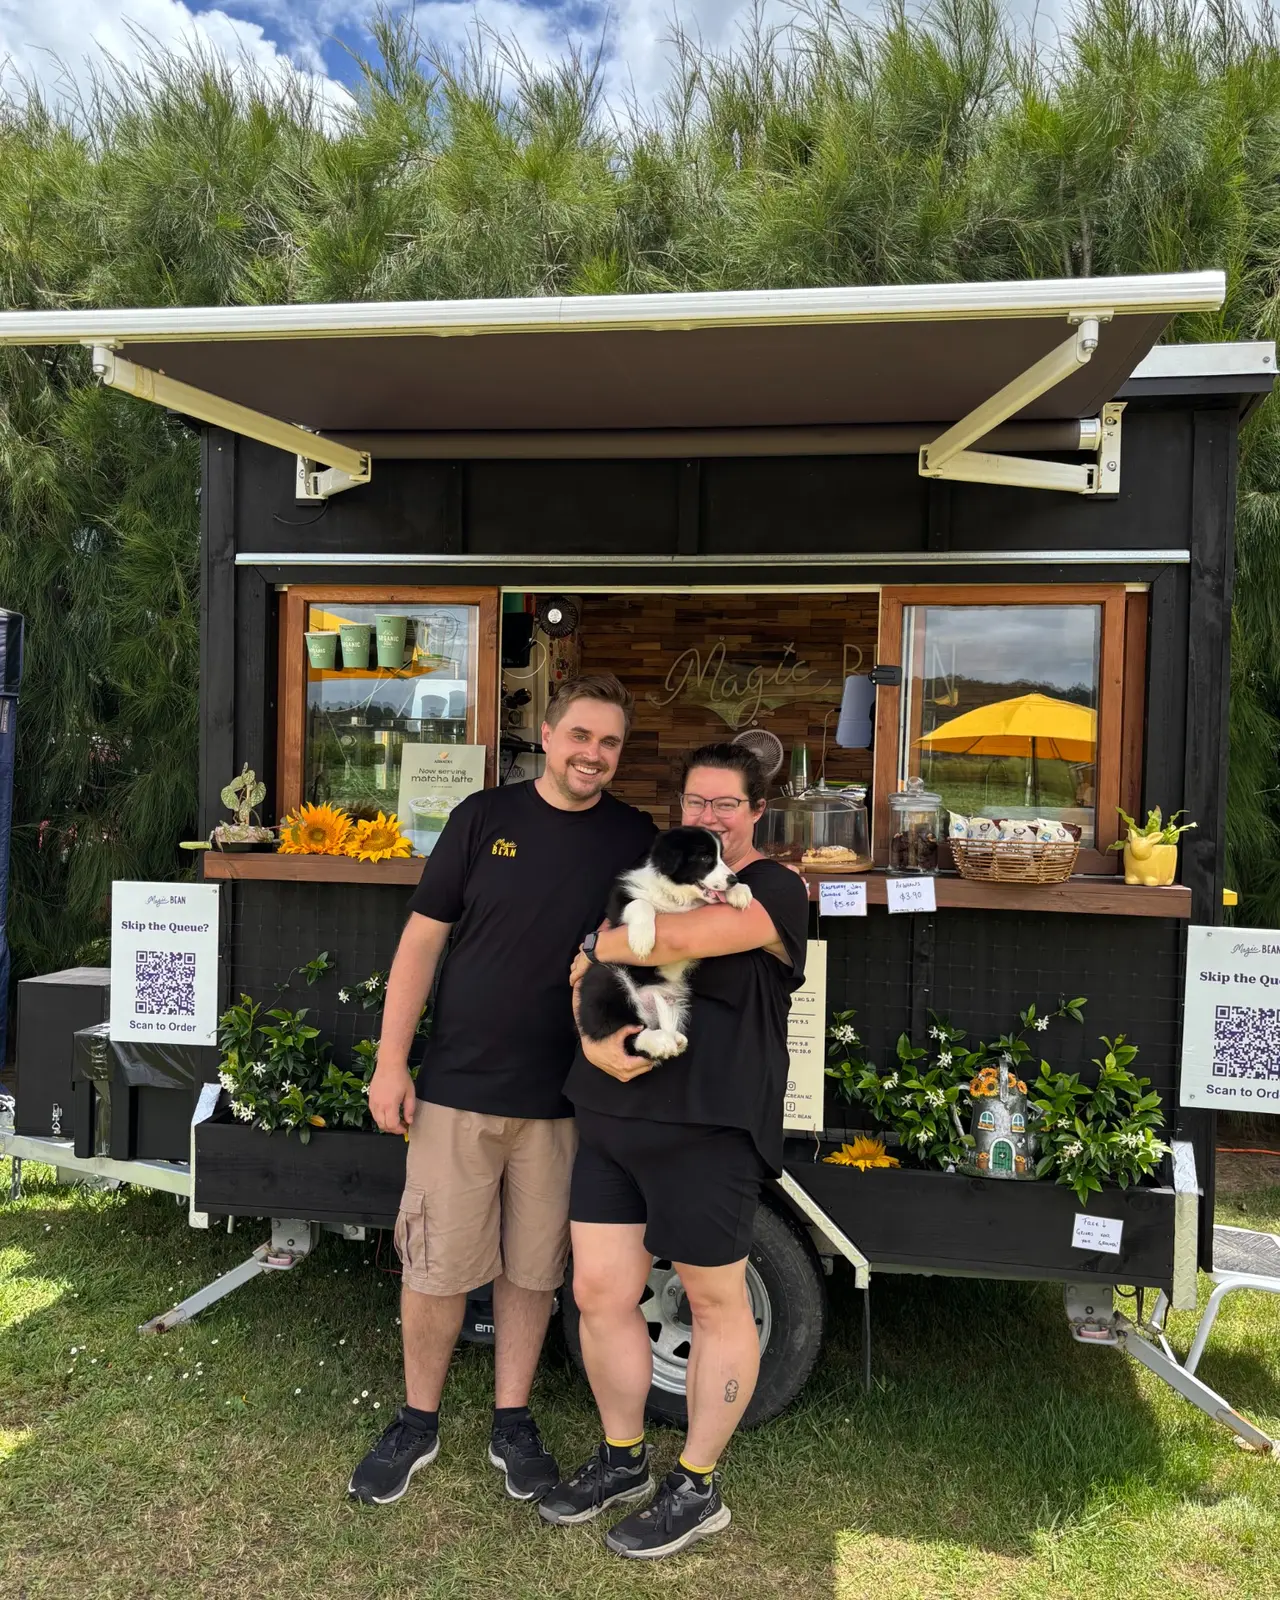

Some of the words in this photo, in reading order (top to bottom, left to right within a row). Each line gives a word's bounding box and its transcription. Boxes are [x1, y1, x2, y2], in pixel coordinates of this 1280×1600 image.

[648, 641, 832, 731] Magic
[411, 775, 449, 783] matcha
[452, 774, 474, 783] latte
[438, 768, 467, 776] serving
[145, 895, 170, 908] Magic
[170, 895, 187, 905] BEAN
[899, 891, 923, 903] $3.90
[121, 920, 146, 933] Skip
[148, 921, 167, 931] the
[168, 922, 210, 934] Queue?
[1230, 942, 1261, 958] Magic
[1199, 970, 1231, 985] Skip
[1233, 972, 1257, 984] the
[1259, 974, 1280, 988] Qu
[129, 1020, 154, 1030] Scan
[156, 1022, 166, 1031] to
[168, 1022, 197, 1032] Order
[1205, 1084, 1237, 1096] Scan
[1240, 1087, 1253, 1098] to
